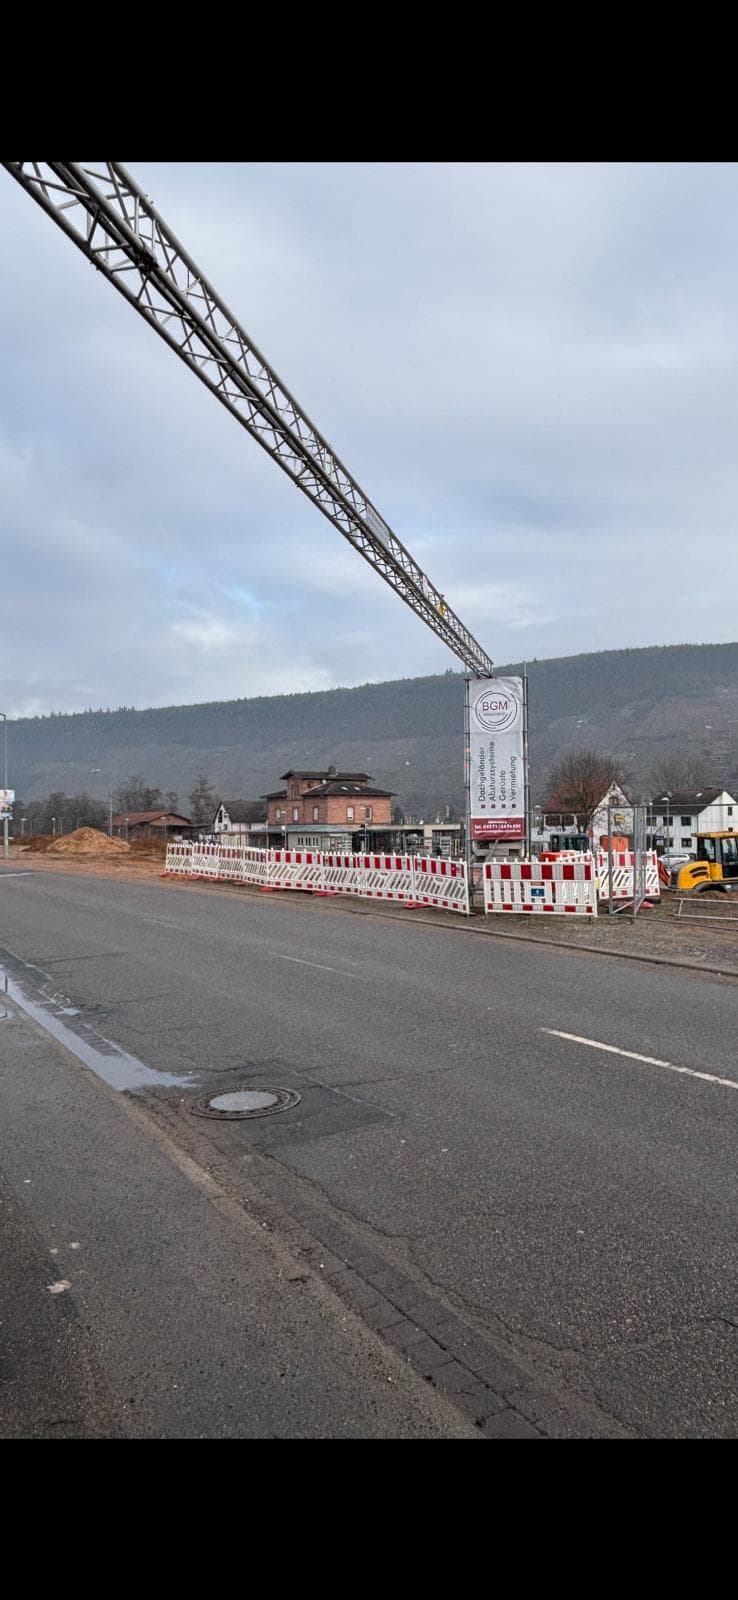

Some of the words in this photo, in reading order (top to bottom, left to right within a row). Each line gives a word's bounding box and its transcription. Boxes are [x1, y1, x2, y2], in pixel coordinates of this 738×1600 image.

[482, 701, 508, 711] BGM
[478, 746, 487, 802] Dachgeländer
[488, 741, 496, 802] Absturzsysteme
[499, 770, 507, 802] Gerüste
[509, 756, 517, 802] Vermietung
